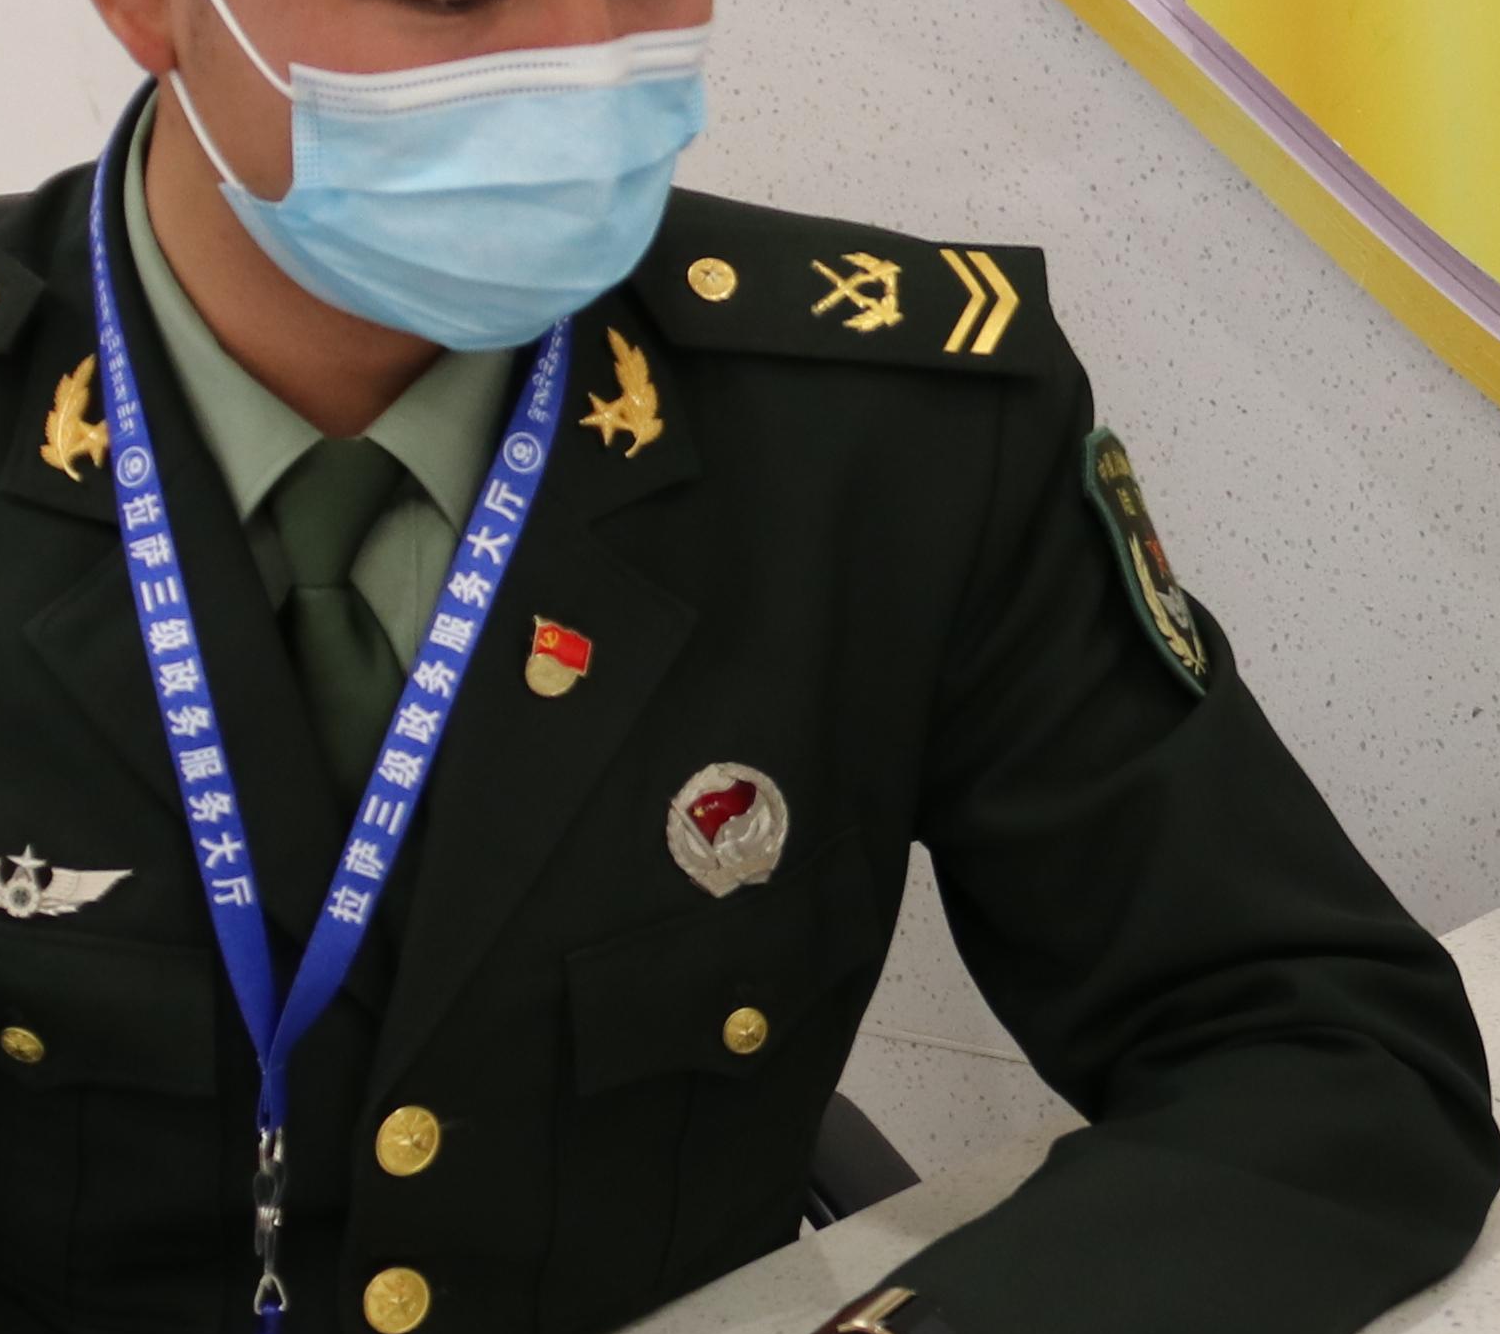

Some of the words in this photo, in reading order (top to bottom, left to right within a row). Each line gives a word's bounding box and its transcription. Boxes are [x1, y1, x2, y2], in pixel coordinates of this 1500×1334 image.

[122, 491, 255, 910] 拉萨三级政务服务大厅
[328, 478, 531, 926] 拉萨三级政务服务大厅
